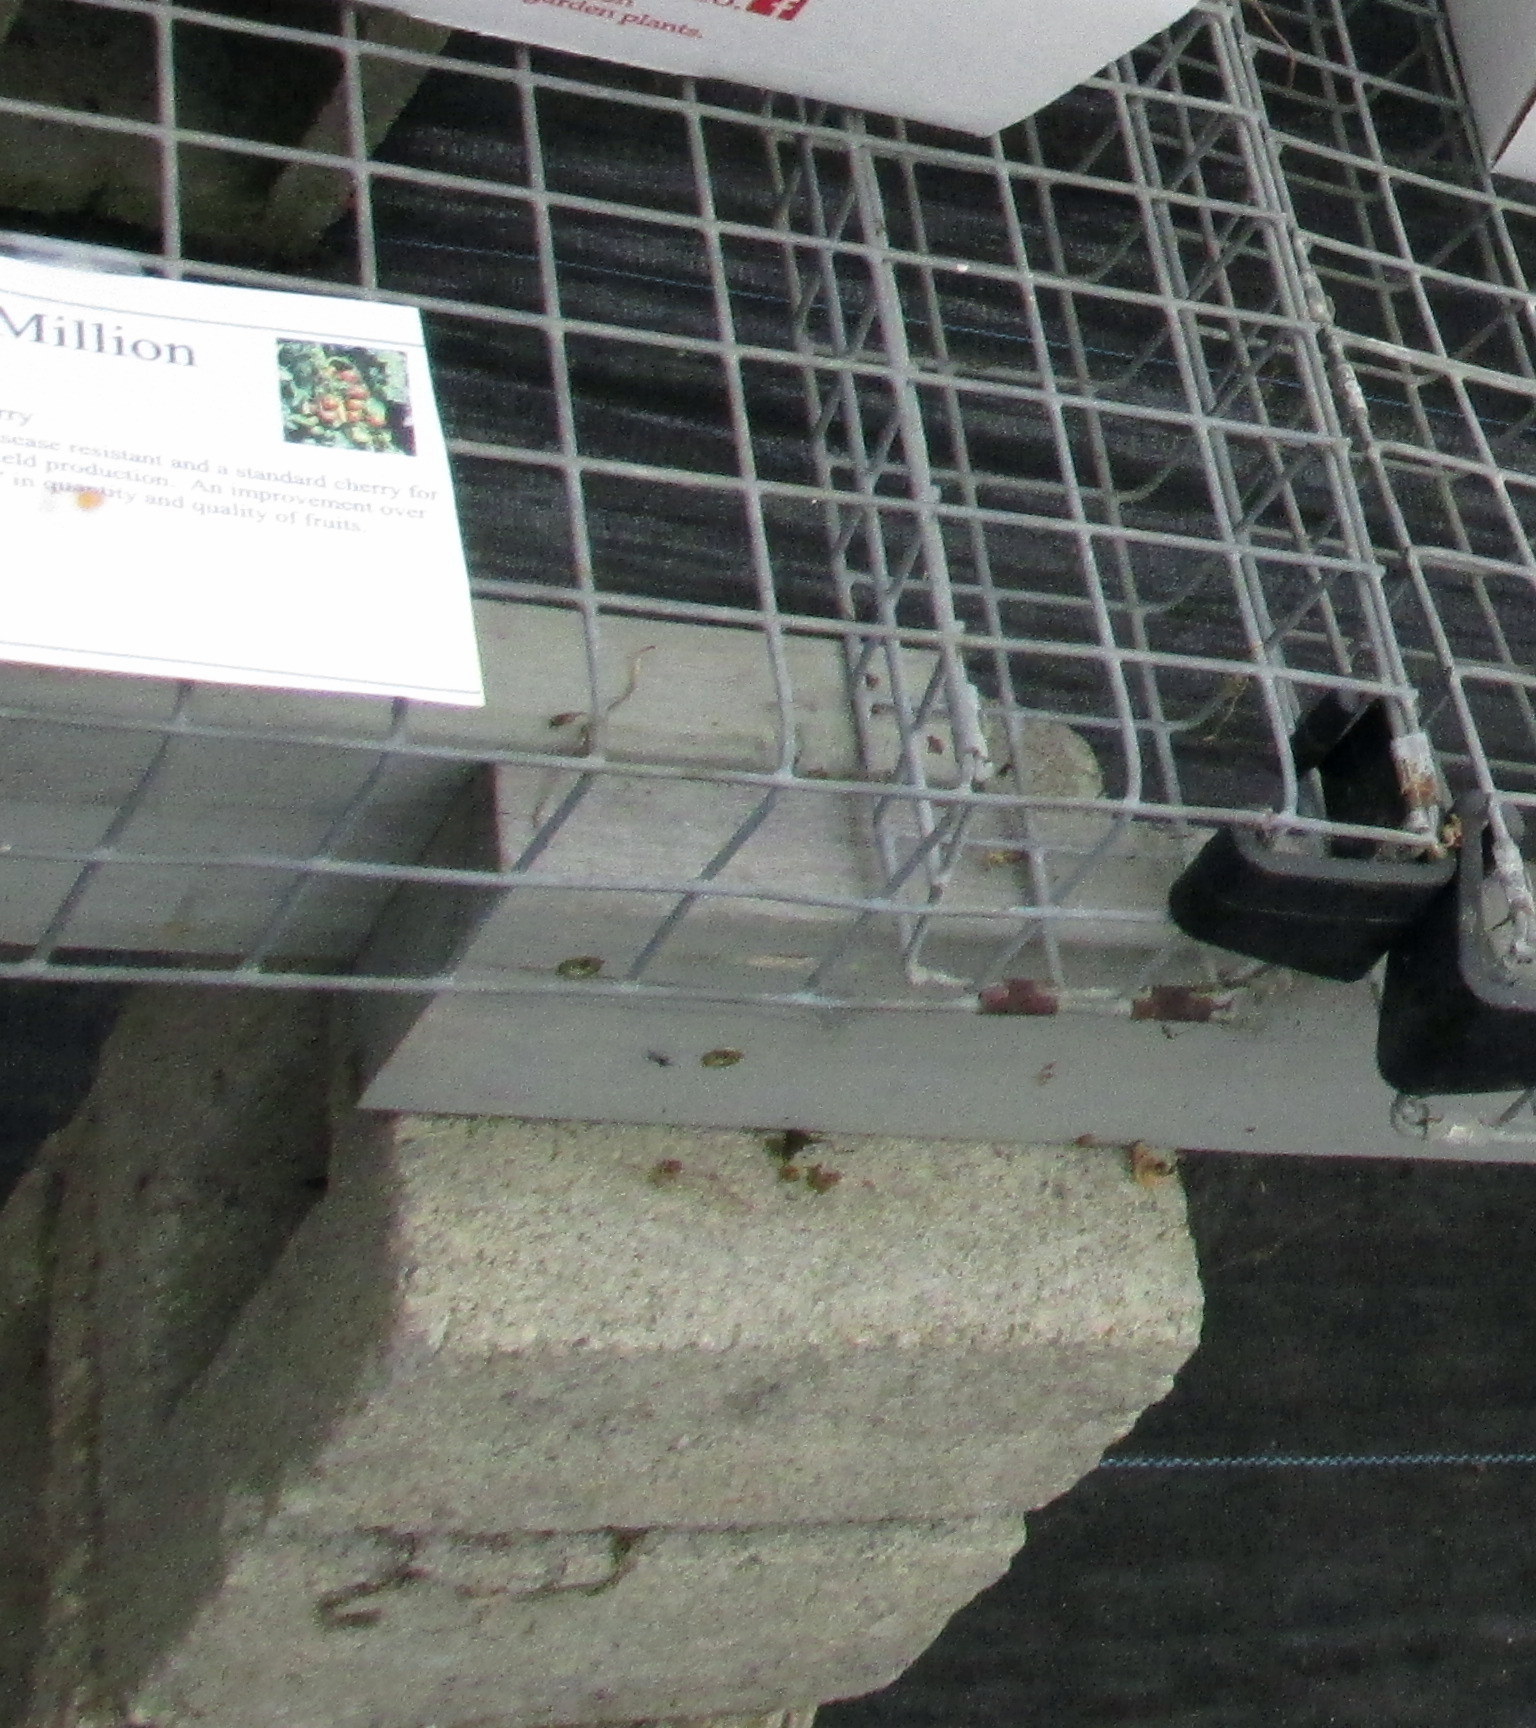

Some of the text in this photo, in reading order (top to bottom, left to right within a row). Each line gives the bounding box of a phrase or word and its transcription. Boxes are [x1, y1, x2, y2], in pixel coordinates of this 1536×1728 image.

[0, 306, 198, 369] Million
[13, 475, 35, 488] in
[145, 493, 184, 509] and
[192, 499, 268, 524] quality
[275, 509, 296, 524] of
[46, 459, 175, 488] production.
[192, 478, 222, 496] An
[231, 485, 372, 513] improvement
[379, 505, 427, 520] over
[69, 443, 162, 467] resistant
[171, 458, 209, 474] and
[218, 465, 229, 476] a
[236, 467, 326, 490] standard
[334, 478, 400, 500] cherry
[409, 485, 437, 501] for
